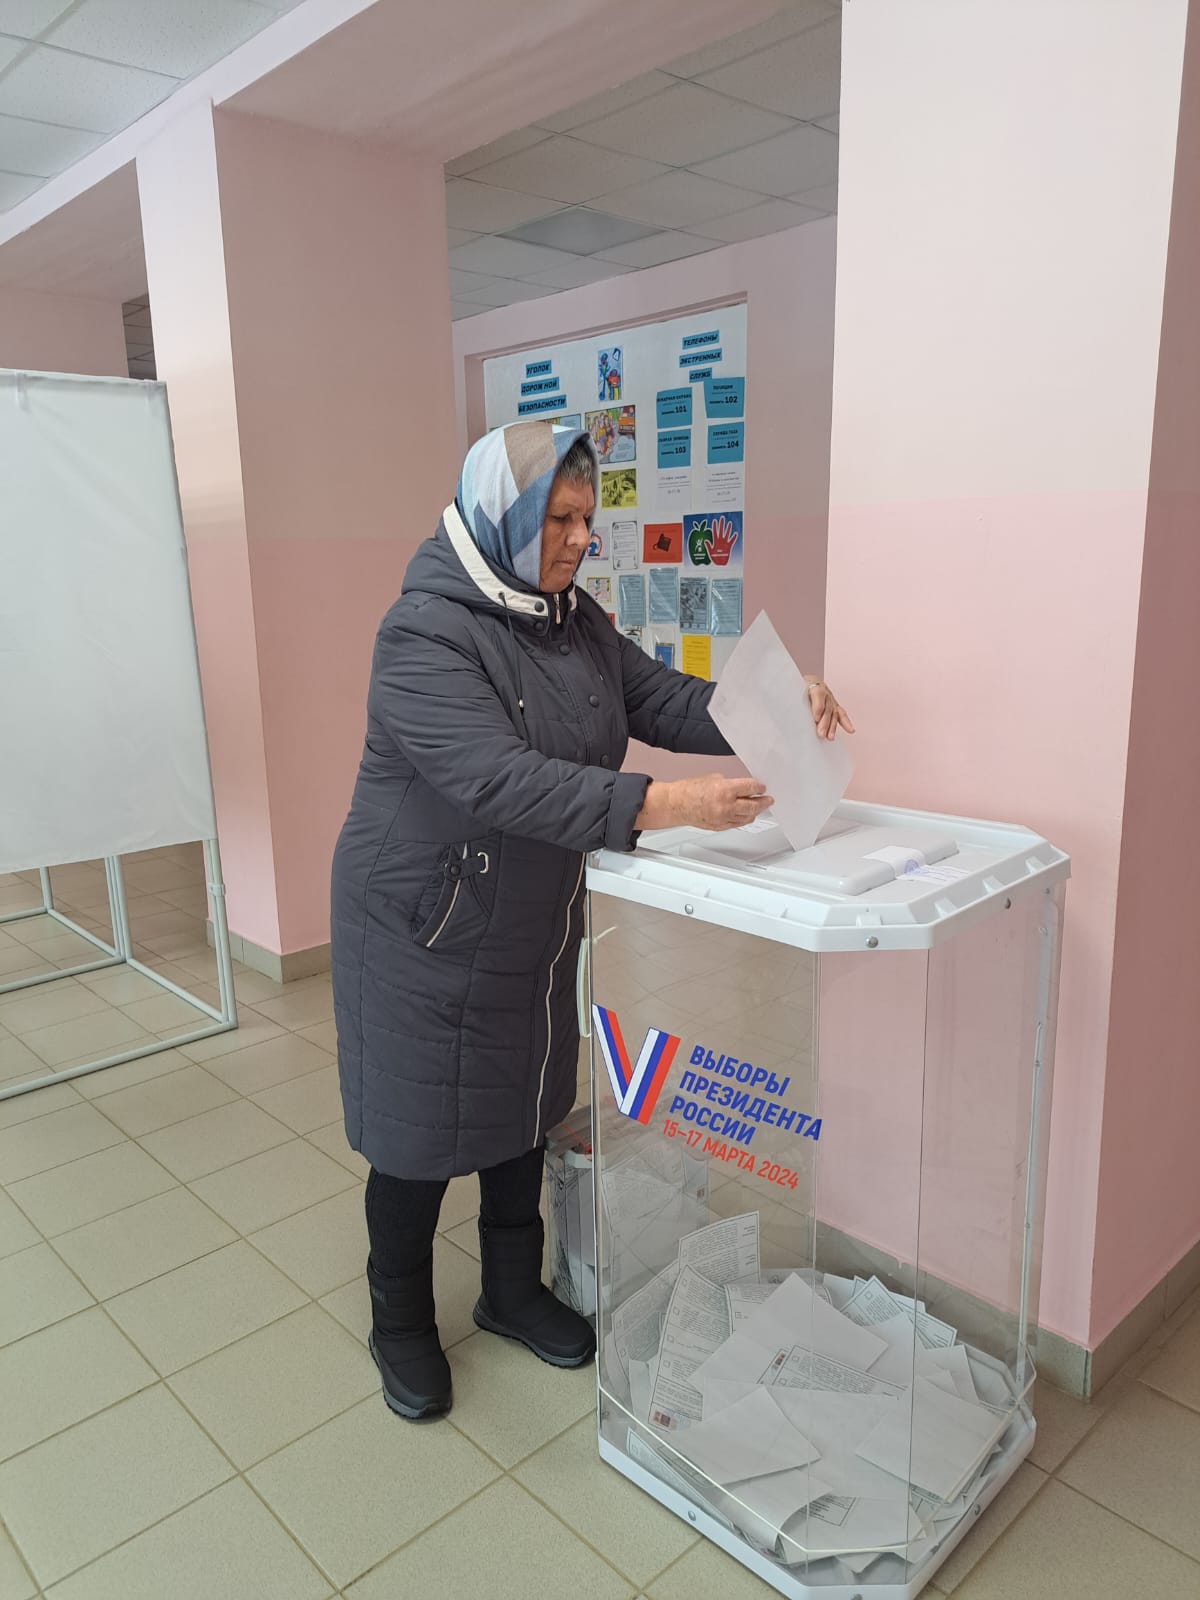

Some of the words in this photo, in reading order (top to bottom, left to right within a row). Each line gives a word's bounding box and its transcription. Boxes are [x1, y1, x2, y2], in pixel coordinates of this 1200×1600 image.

[683, 333, 719, 347] ТЕЛЕФОНЫ
[526, 364, 549, 374] УГОЛОК
[518, 398, 566, 413] БЕЗОПАСНОСТИ
[724, 395, 738, 404] 102
[675, 405, 687, 413] 101
[689, 1045, 790, 1097] ВЫБОРЫ
[679, 1070, 823, 1141] ПРЕЗИДЕНТА
[669, 1095, 756, 1145] РОССИИ
[702, 1137, 756, 1173] МАРТА
[757, 1160, 799, 1190] 2024
